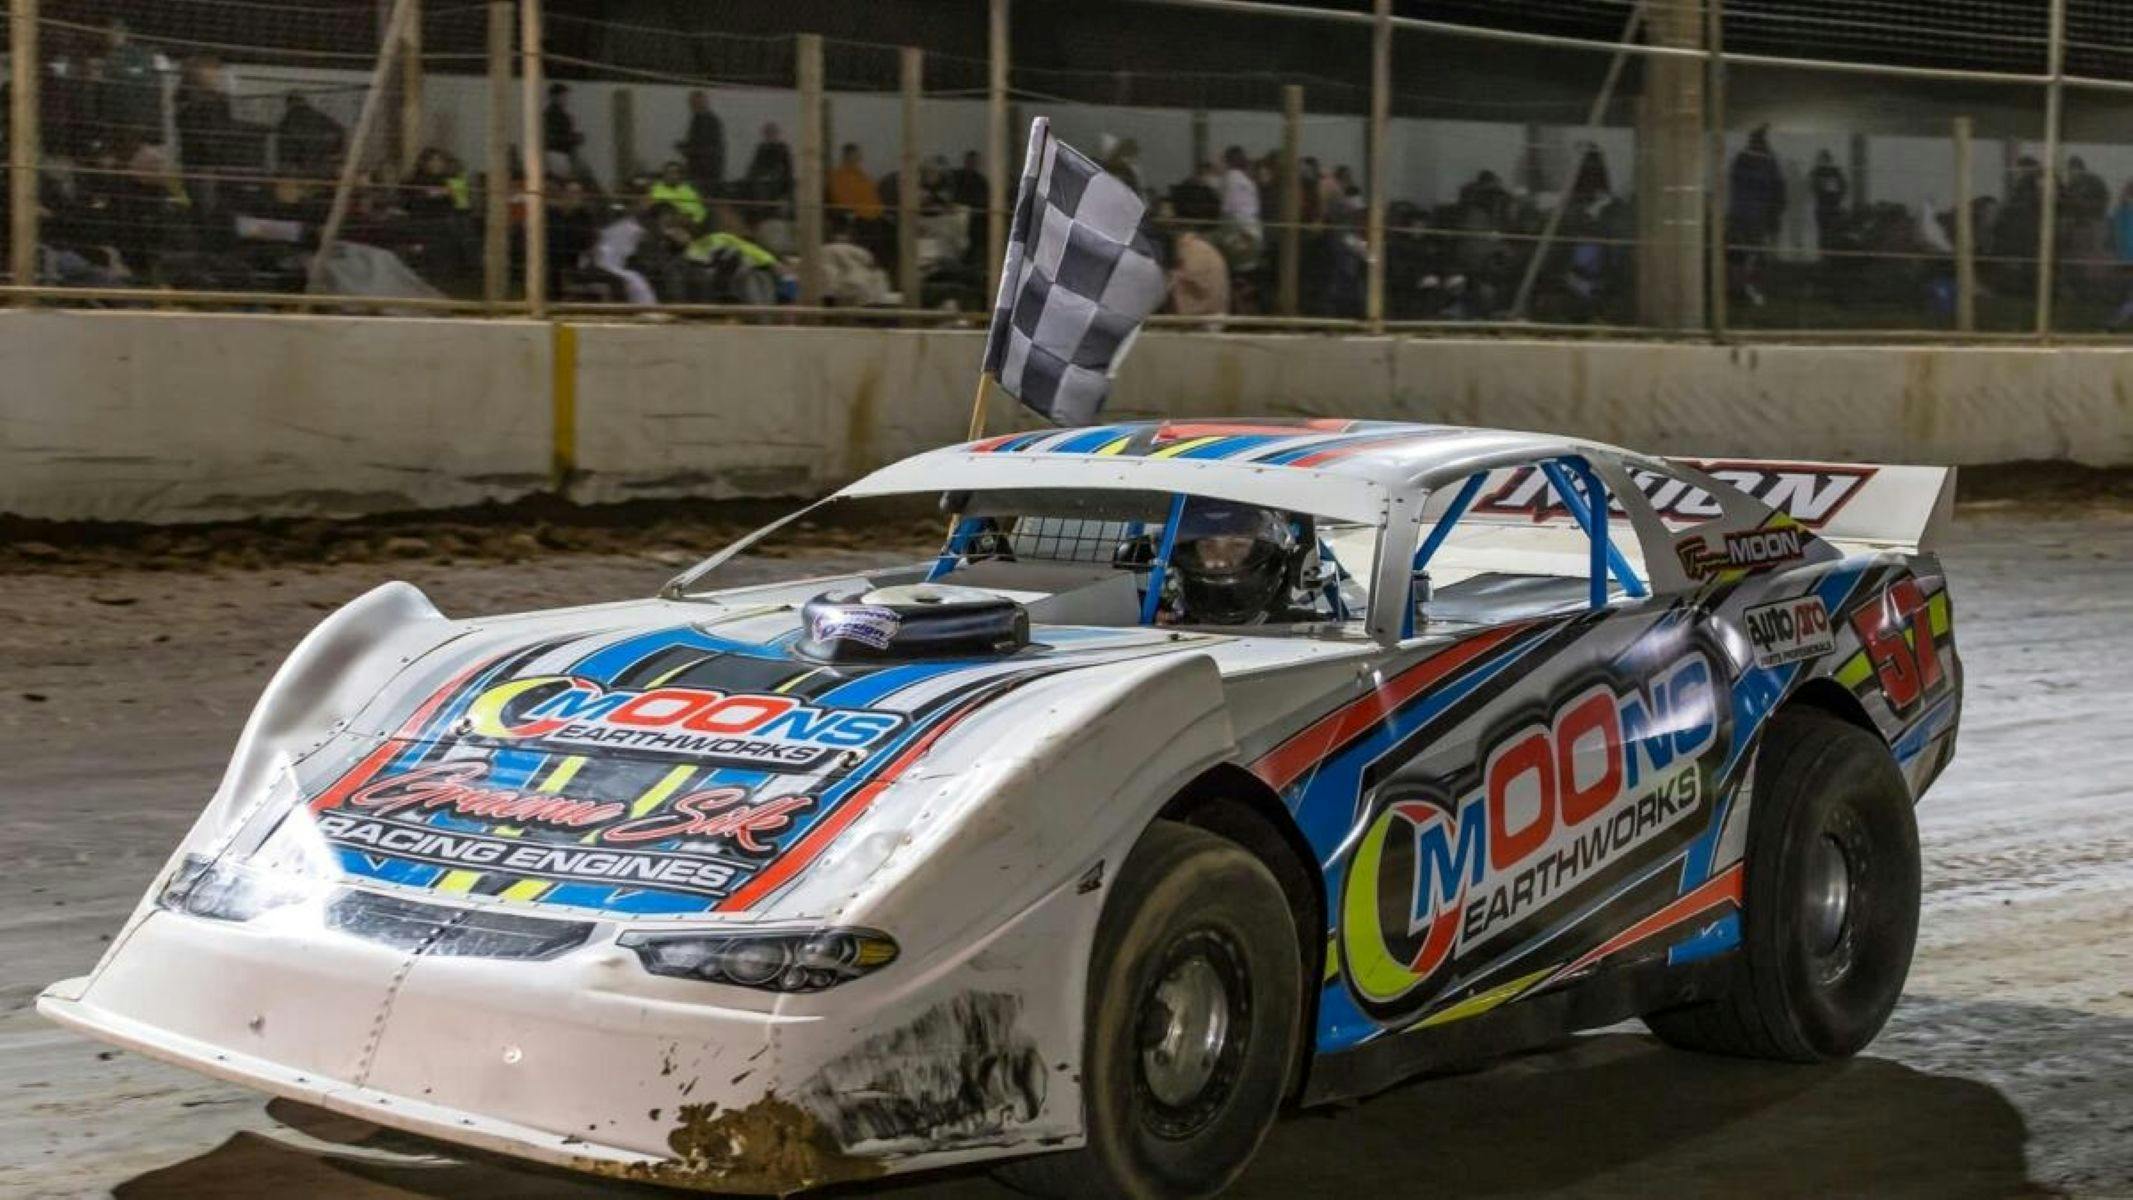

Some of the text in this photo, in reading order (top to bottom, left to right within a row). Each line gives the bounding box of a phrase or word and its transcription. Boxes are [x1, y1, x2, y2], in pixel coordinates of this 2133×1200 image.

[1728, 531, 1800, 565] MOON
[1851, 580, 1942, 708] 57
[531, 688, 902, 745] MOONS
[558, 725, 826, 762] EARTHWORKS
[1416, 651, 1716, 920] MOONS
[319, 816, 739, 888] RACING ENGINES
[1462, 765, 1698, 942] EARTHWORKS
